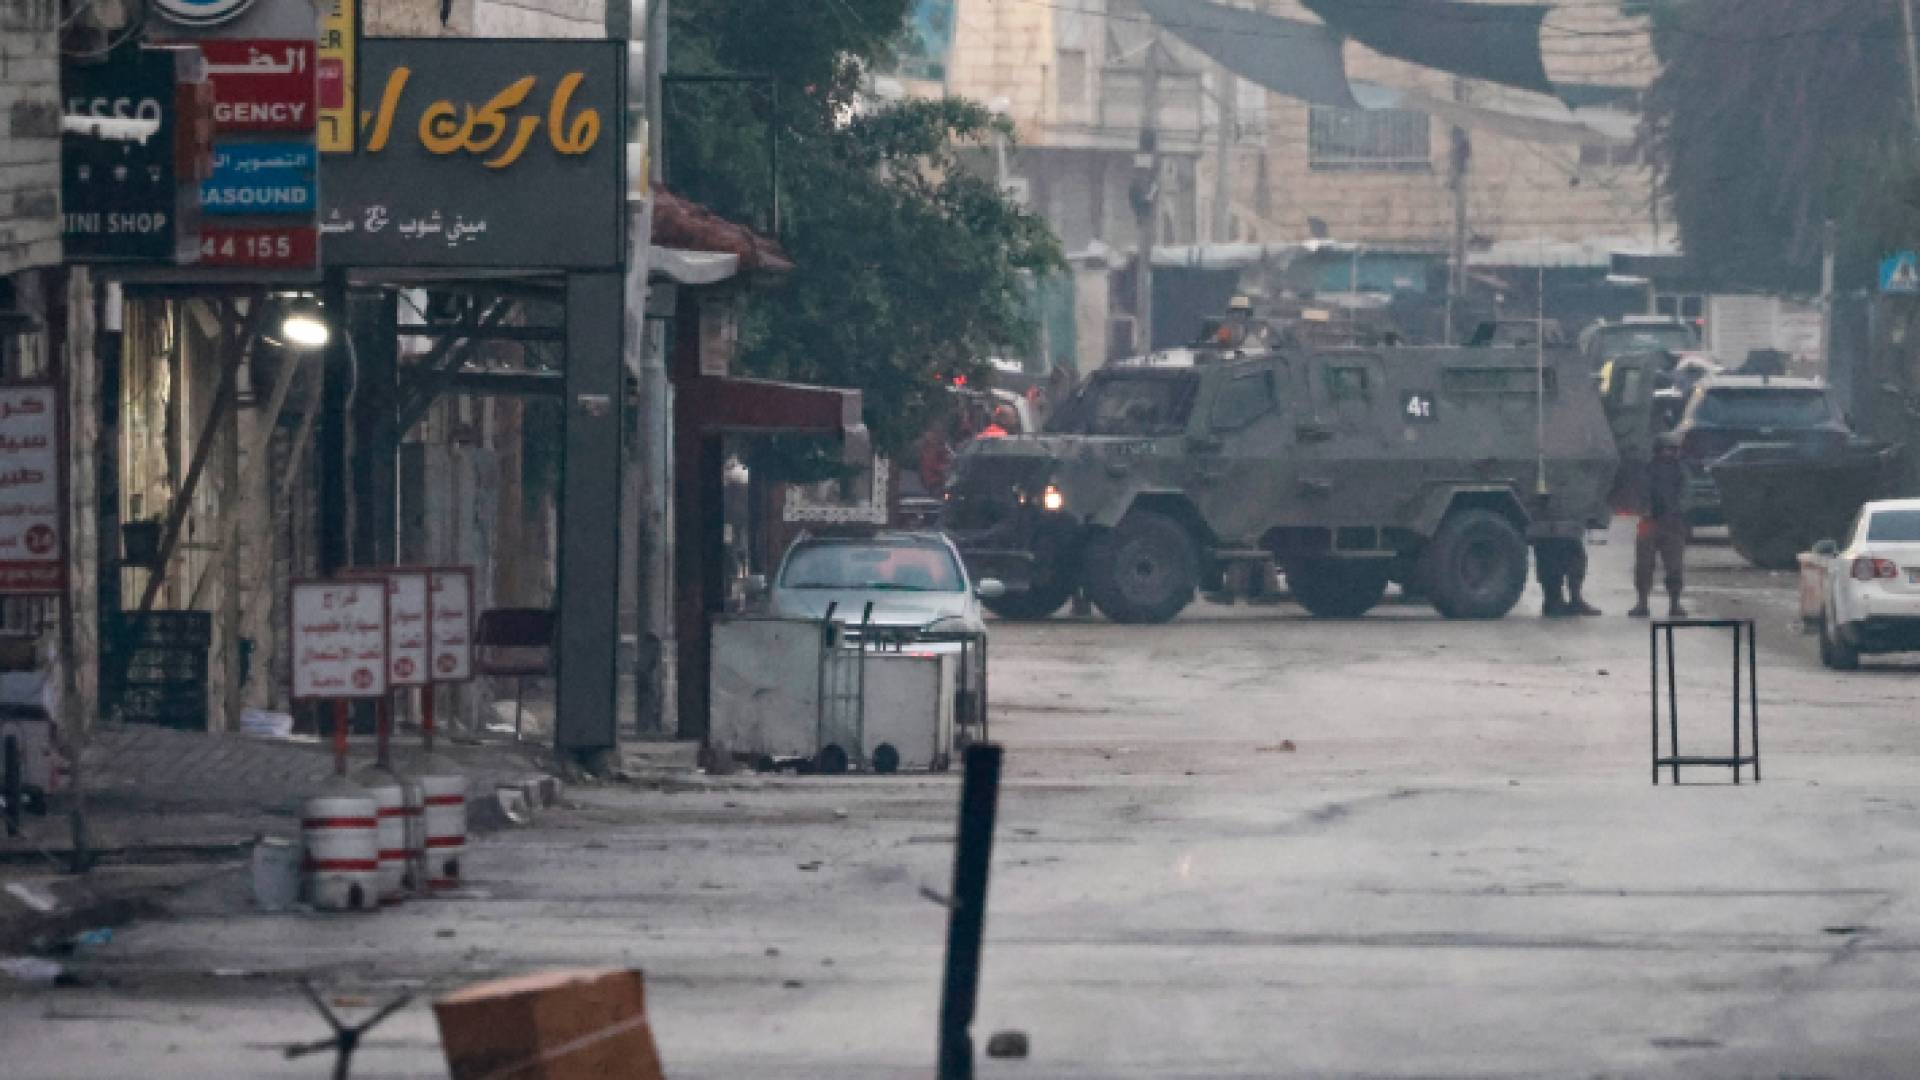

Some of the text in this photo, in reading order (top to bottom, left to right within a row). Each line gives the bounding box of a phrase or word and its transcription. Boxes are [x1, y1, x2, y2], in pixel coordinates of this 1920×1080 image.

[213, 102, 306, 122] GENCY
[107, 212, 166, 233] SHOP
[319, 207, 355, 236] مش
[248, 235, 290, 258] 155
